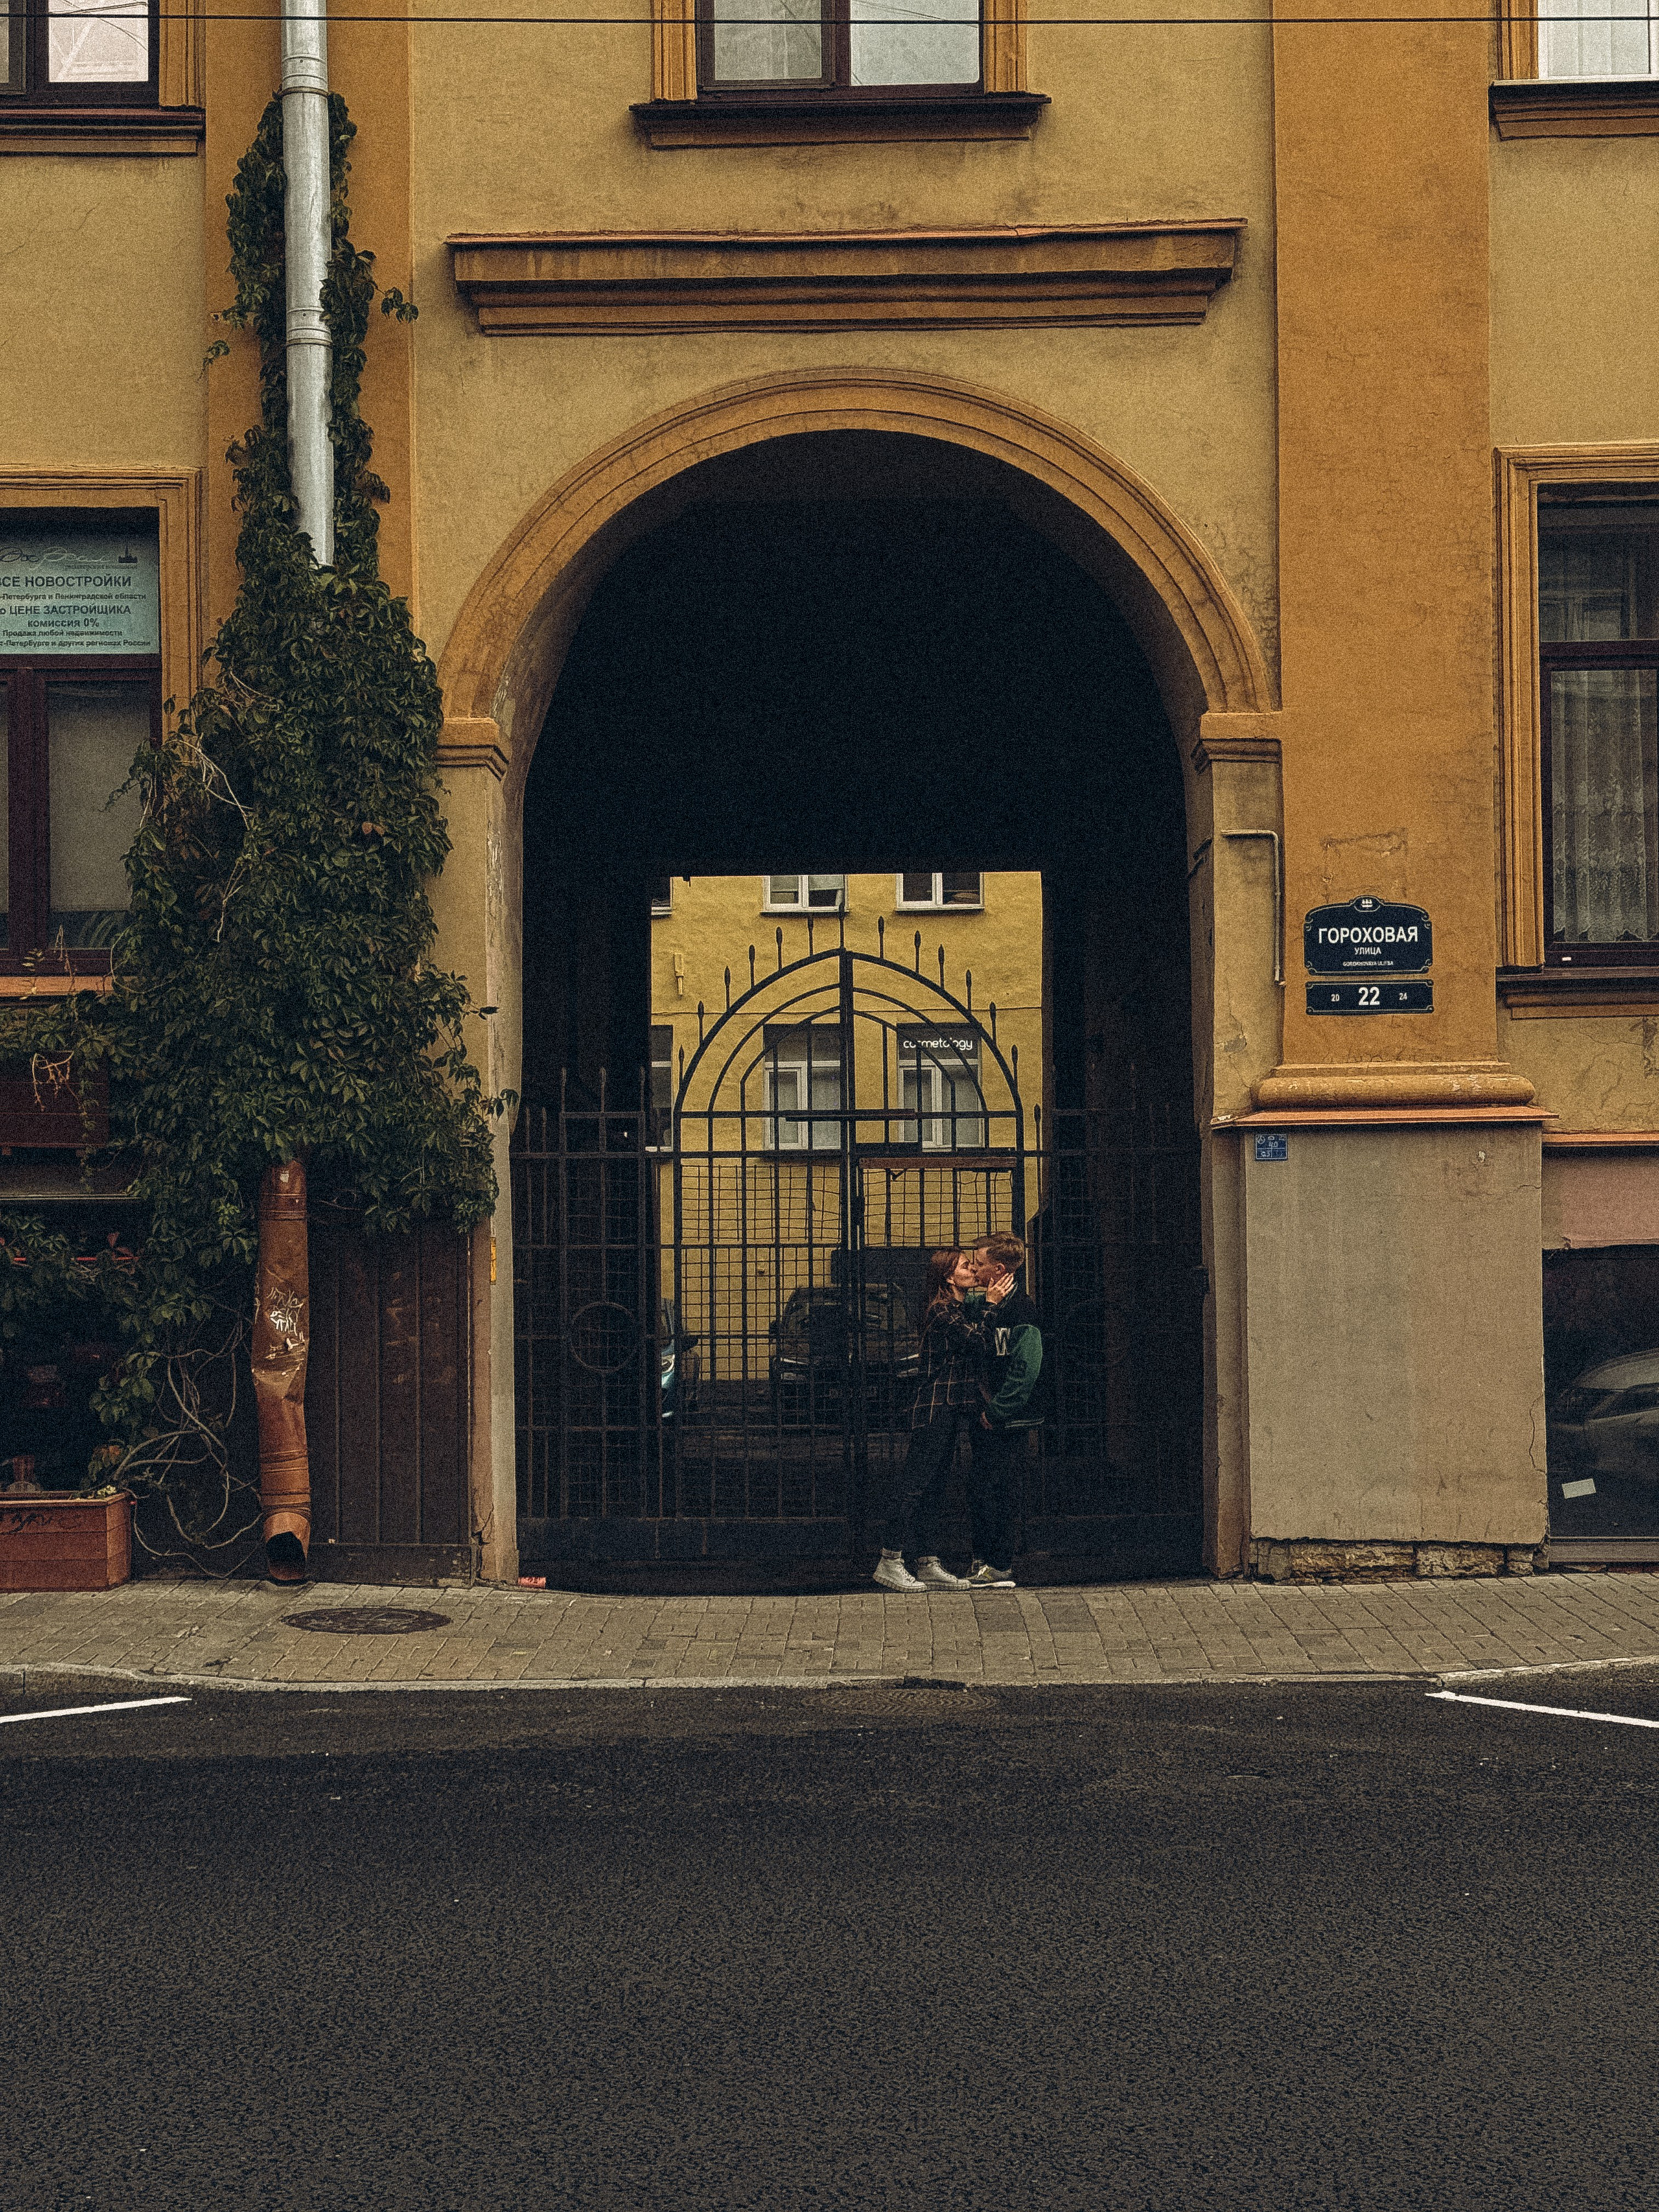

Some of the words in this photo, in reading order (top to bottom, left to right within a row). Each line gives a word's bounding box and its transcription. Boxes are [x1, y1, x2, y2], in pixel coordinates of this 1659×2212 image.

[25, 574, 132, 587] НОВОСТРОЙКИ
[9, 605, 40, 616] ЦЕНЕ
[43, 603, 132, 616] ЗАСТРОЙЩИКА
[83, 618, 100, 627] 0%
[1318, 926, 1418, 944] ГОРОХОВАЯ
[1354, 947, 1382, 955] УЛИЦА
[1358, 986, 1380, 1005] 22
[903, 1037, 973, 1051] cometoogy
